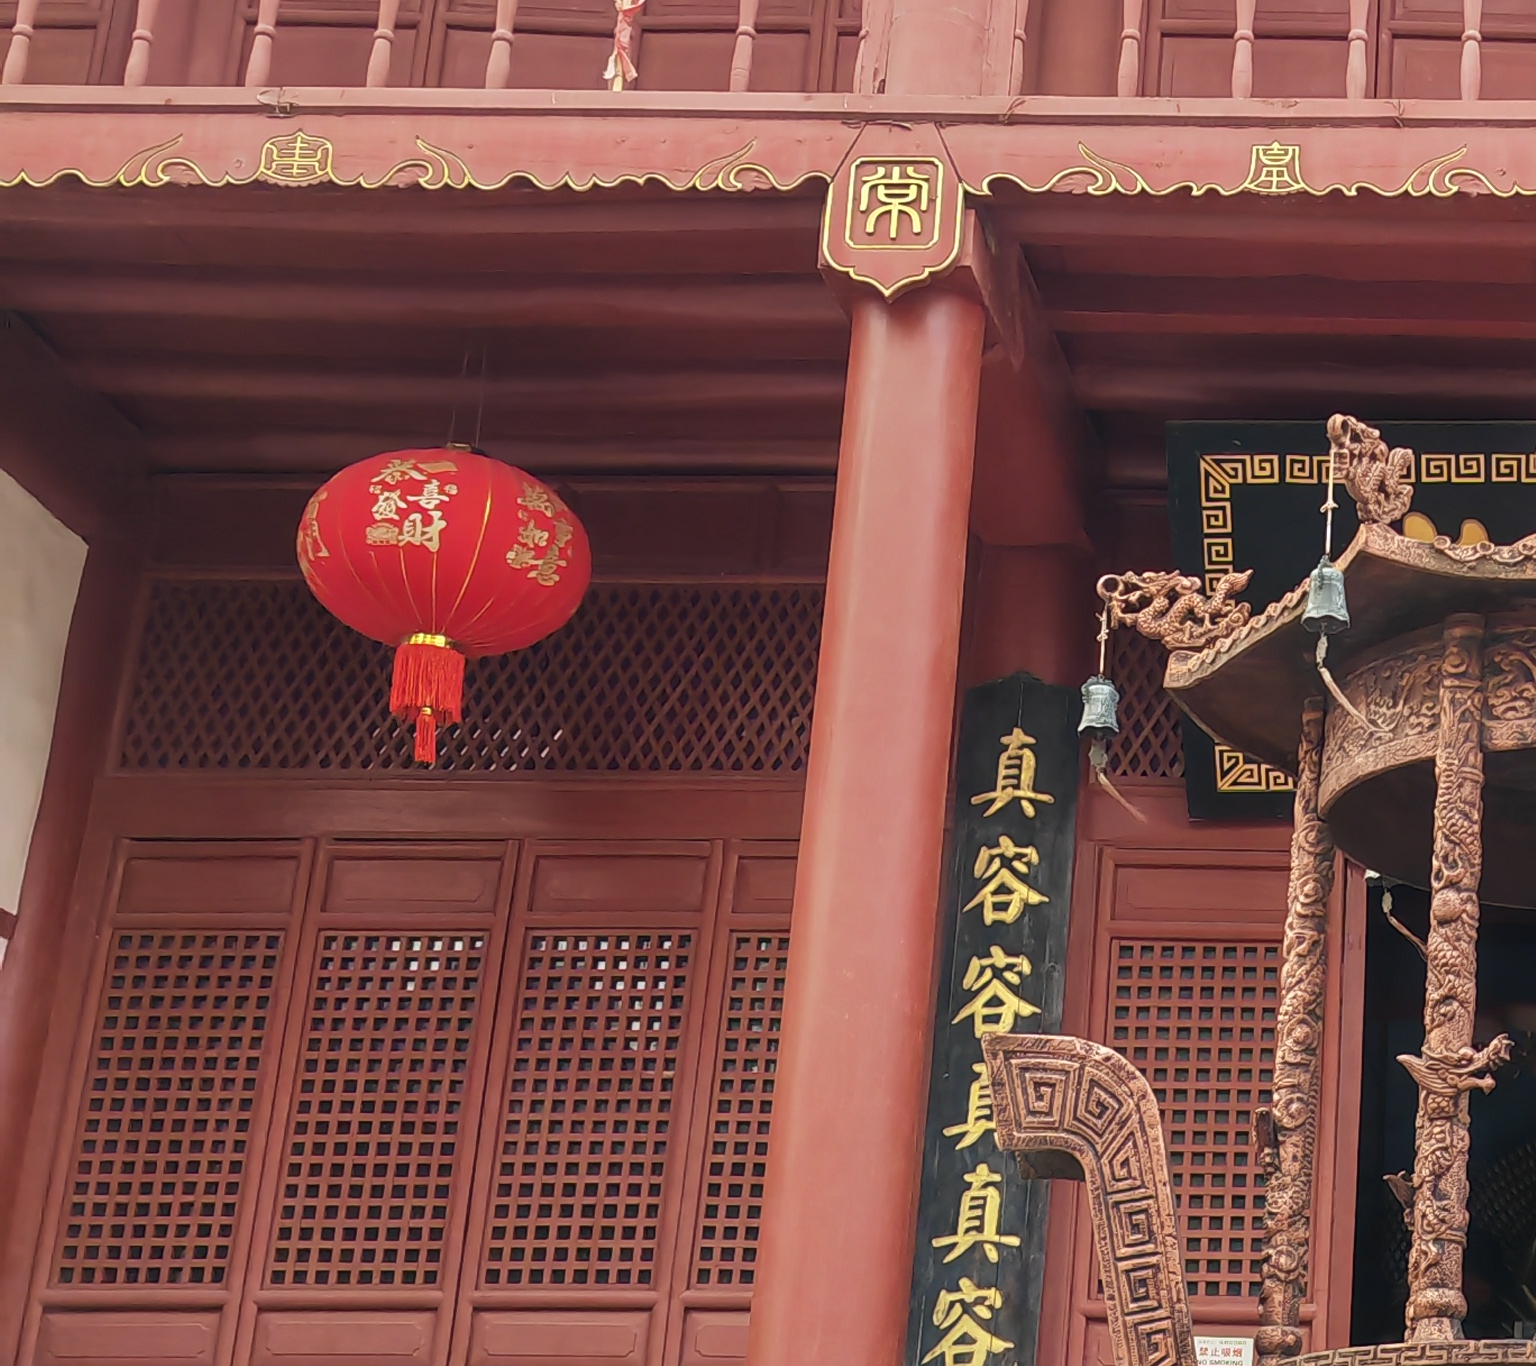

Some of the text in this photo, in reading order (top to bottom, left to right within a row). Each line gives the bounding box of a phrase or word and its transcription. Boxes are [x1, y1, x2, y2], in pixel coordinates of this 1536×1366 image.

[1198, 1346, 1243, 1358] 禁止吸烟
[1209, 1359, 1244, 1366] SMOKING
